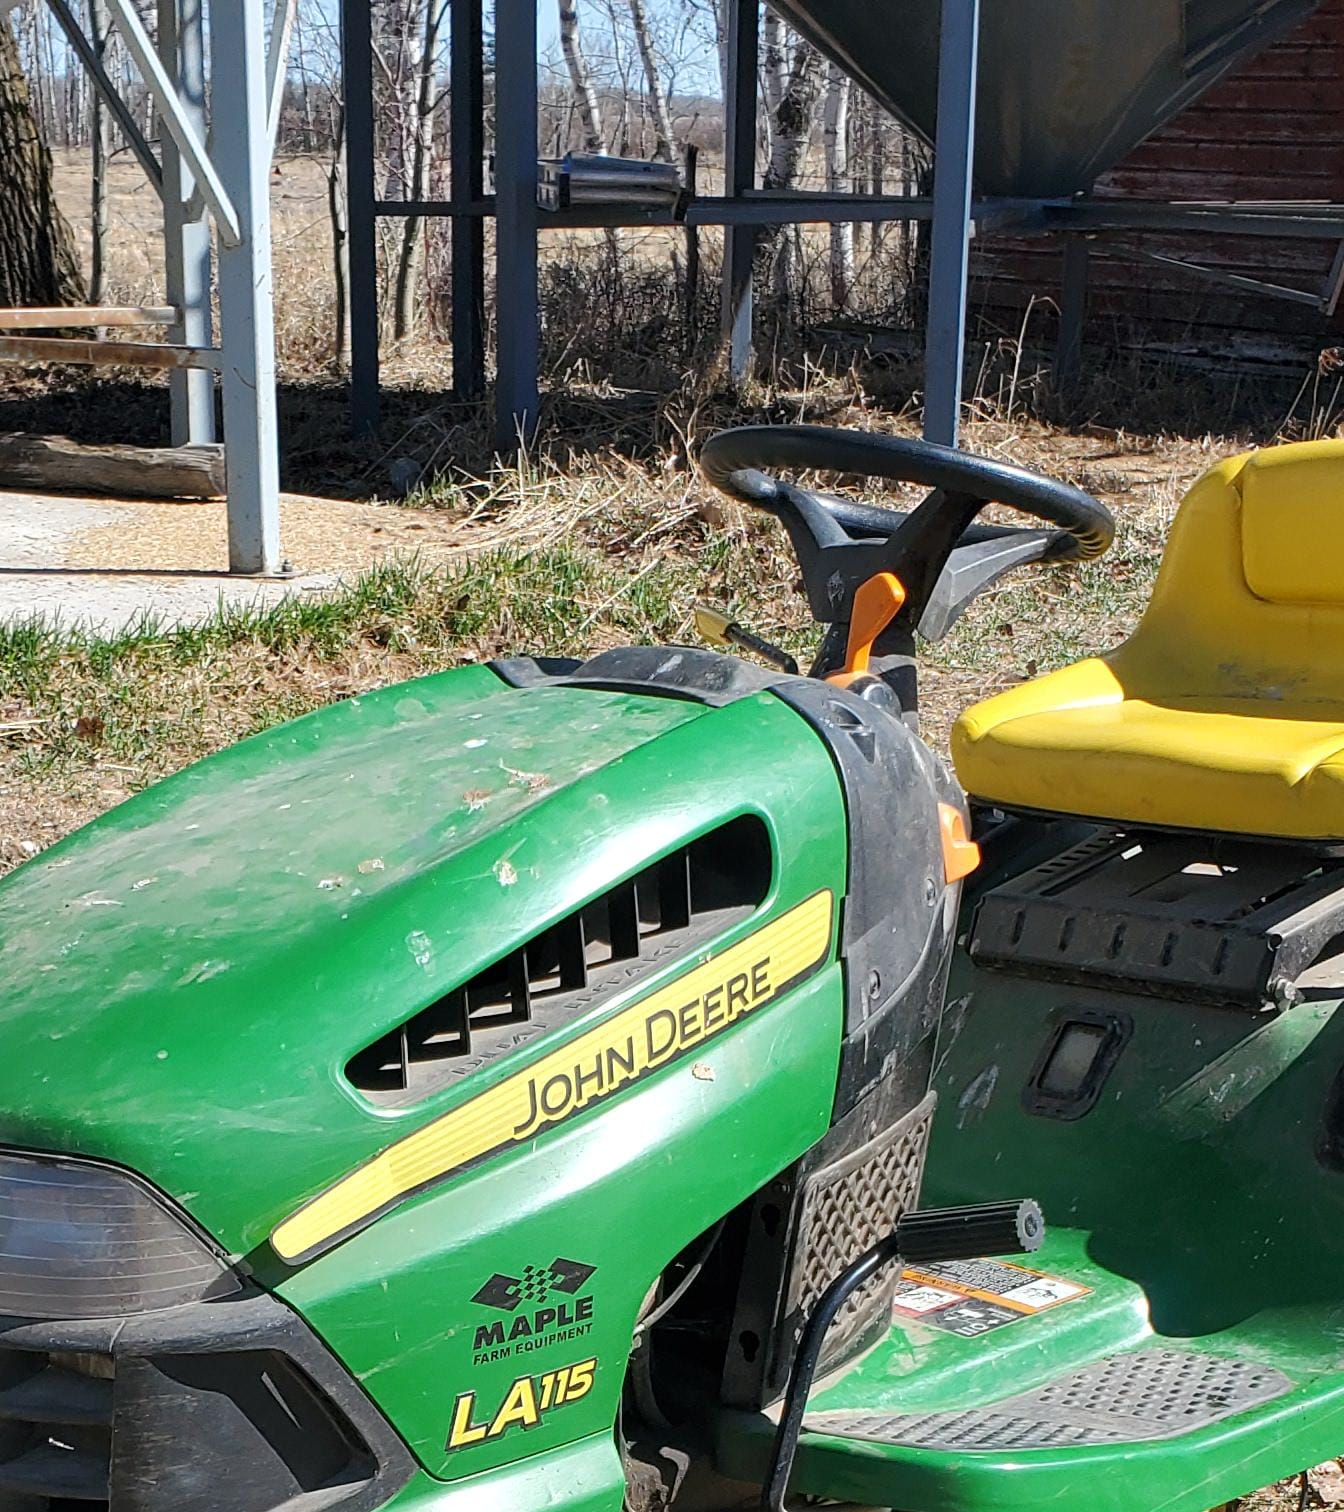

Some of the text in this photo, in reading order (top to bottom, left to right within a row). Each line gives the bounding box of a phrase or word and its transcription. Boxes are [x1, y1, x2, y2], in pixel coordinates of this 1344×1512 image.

[515, 957, 773, 1134] JOHN DEERE
[472, 1295, 594, 1350] MAPLE
[473, 1324, 593, 1366] FARM EQUIPMENT
[446, 1358, 598, 1453] LA115
